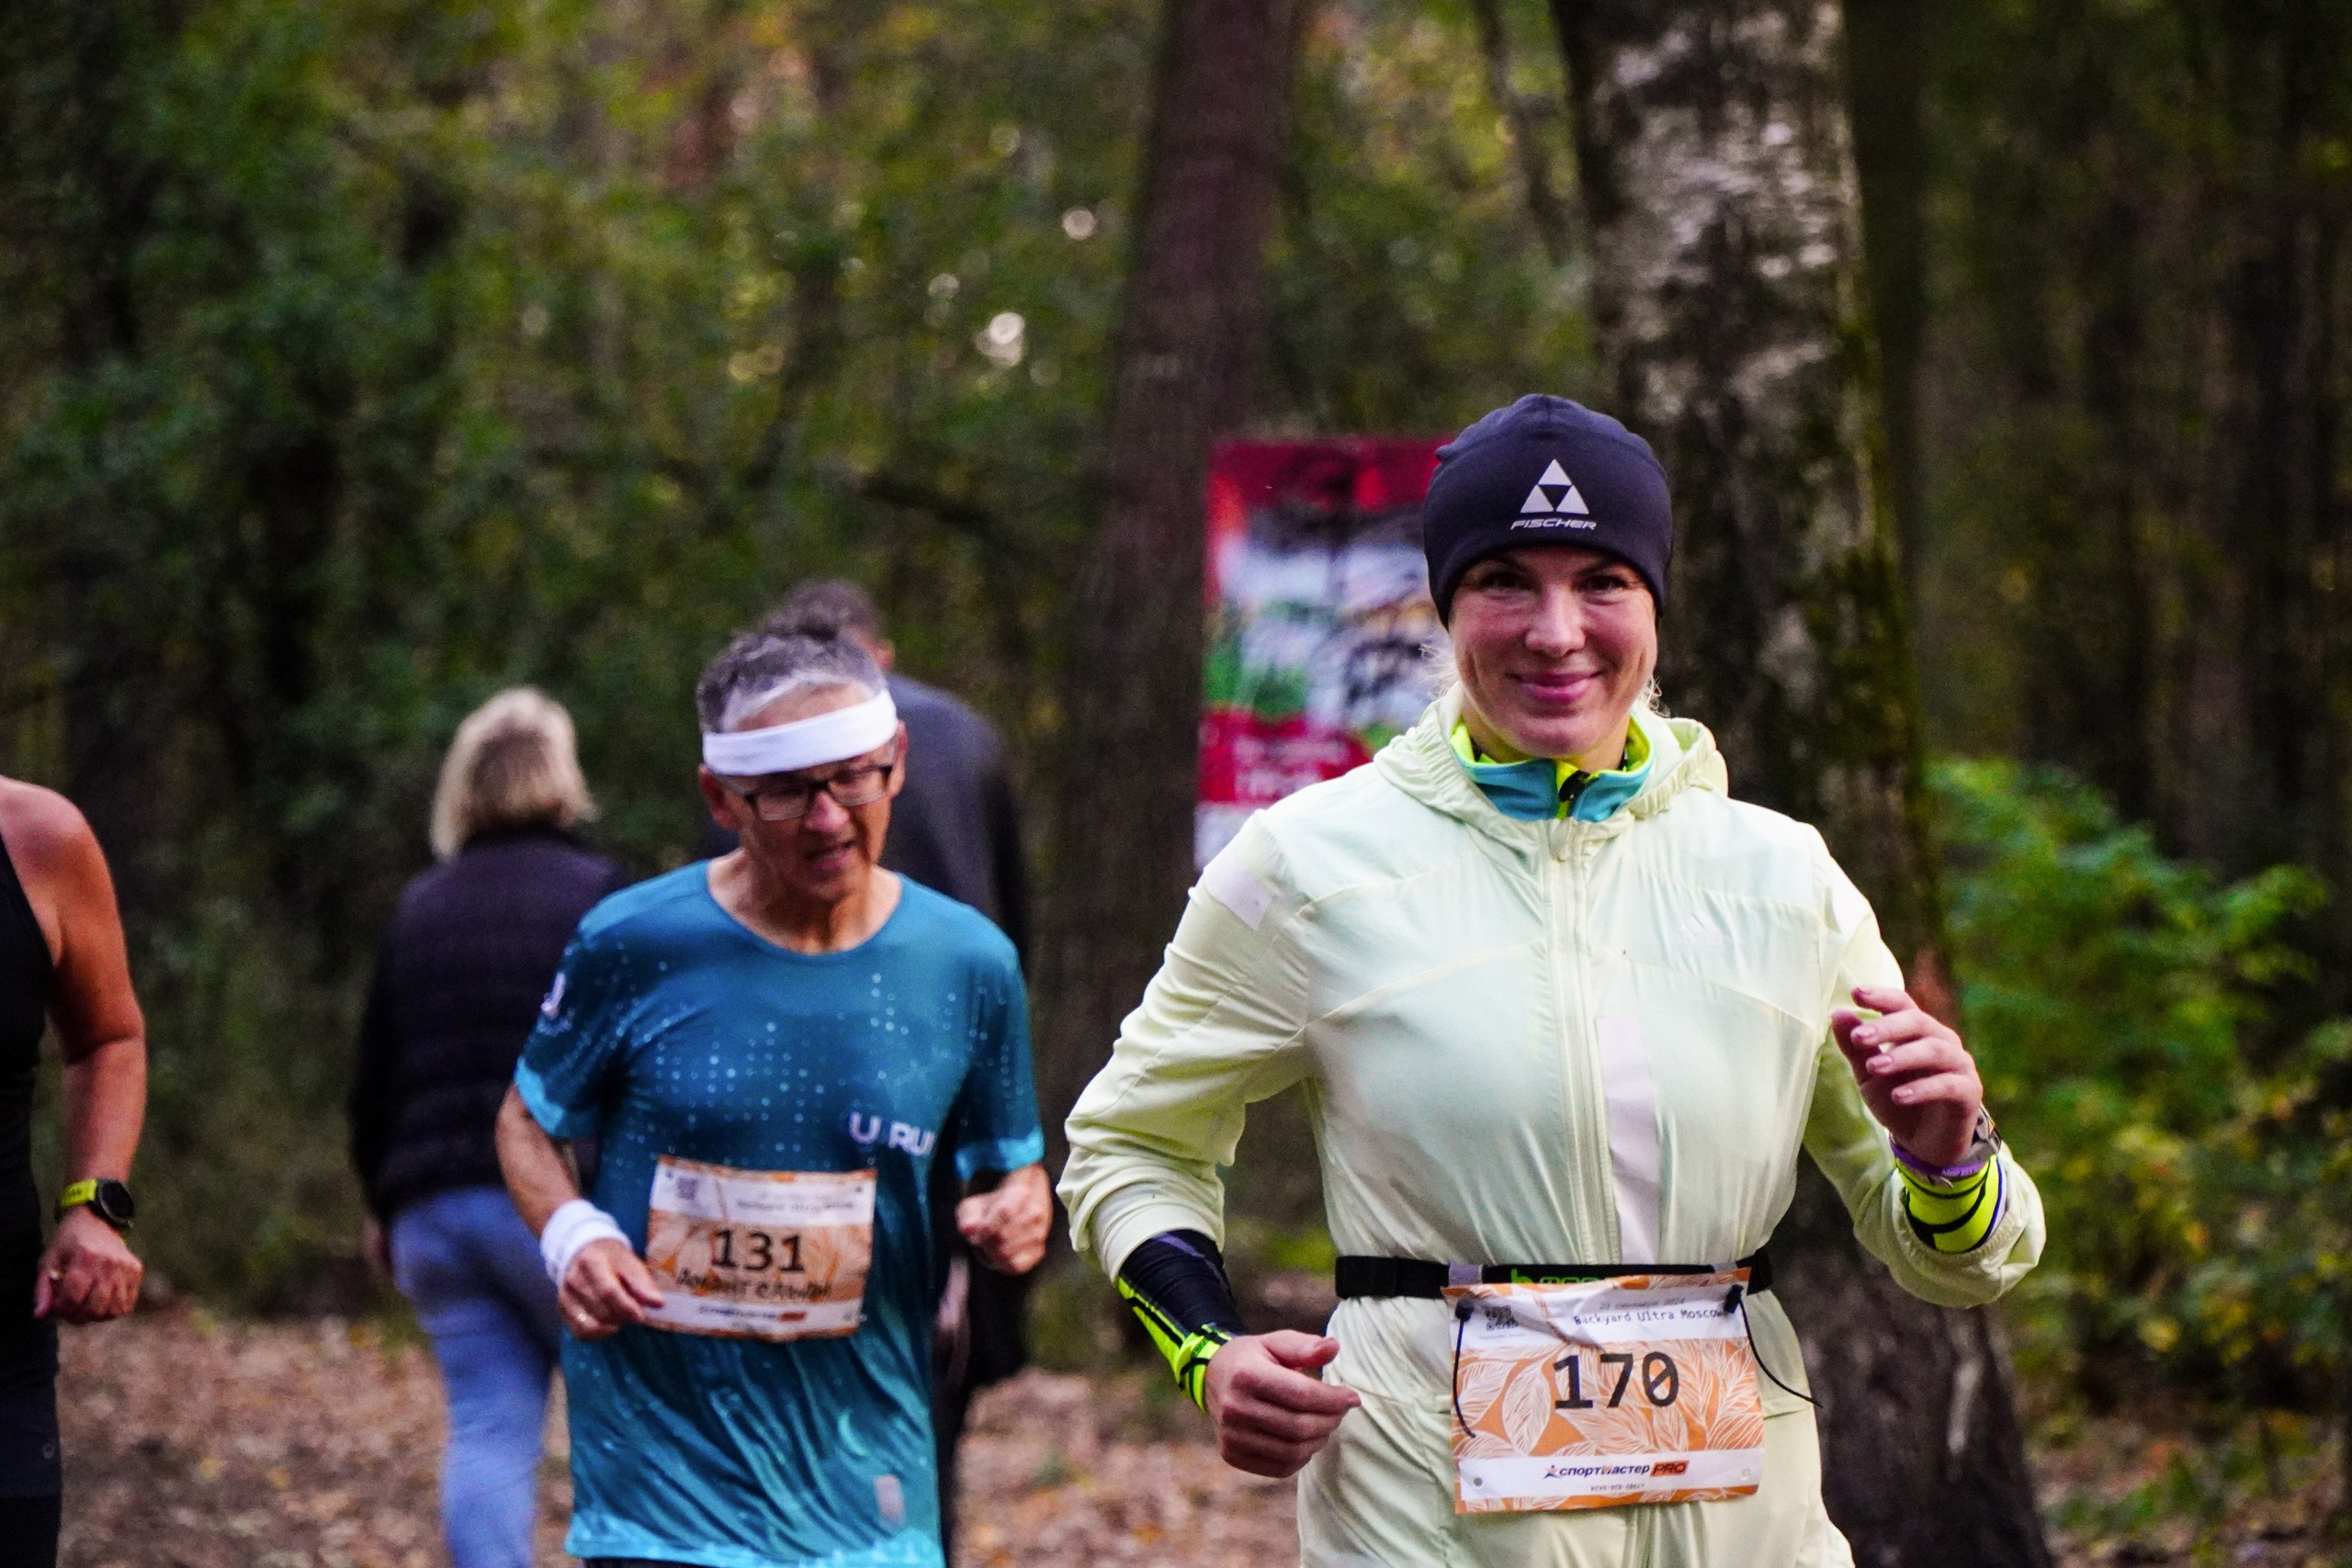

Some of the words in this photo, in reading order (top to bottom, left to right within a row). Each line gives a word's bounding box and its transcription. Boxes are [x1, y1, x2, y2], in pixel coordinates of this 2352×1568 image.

[1510, 518, 1597, 530] FISCHER
[849, 1111, 882, 1145] U
[714, 1228, 806, 1274] 131
[1573, 1312, 1632, 1325] Backyard
[1637, 1306, 1675, 1322] Ultra
[1553, 1350, 1679, 1409] 170
[1653, 1462, 1687, 1474] PRO
